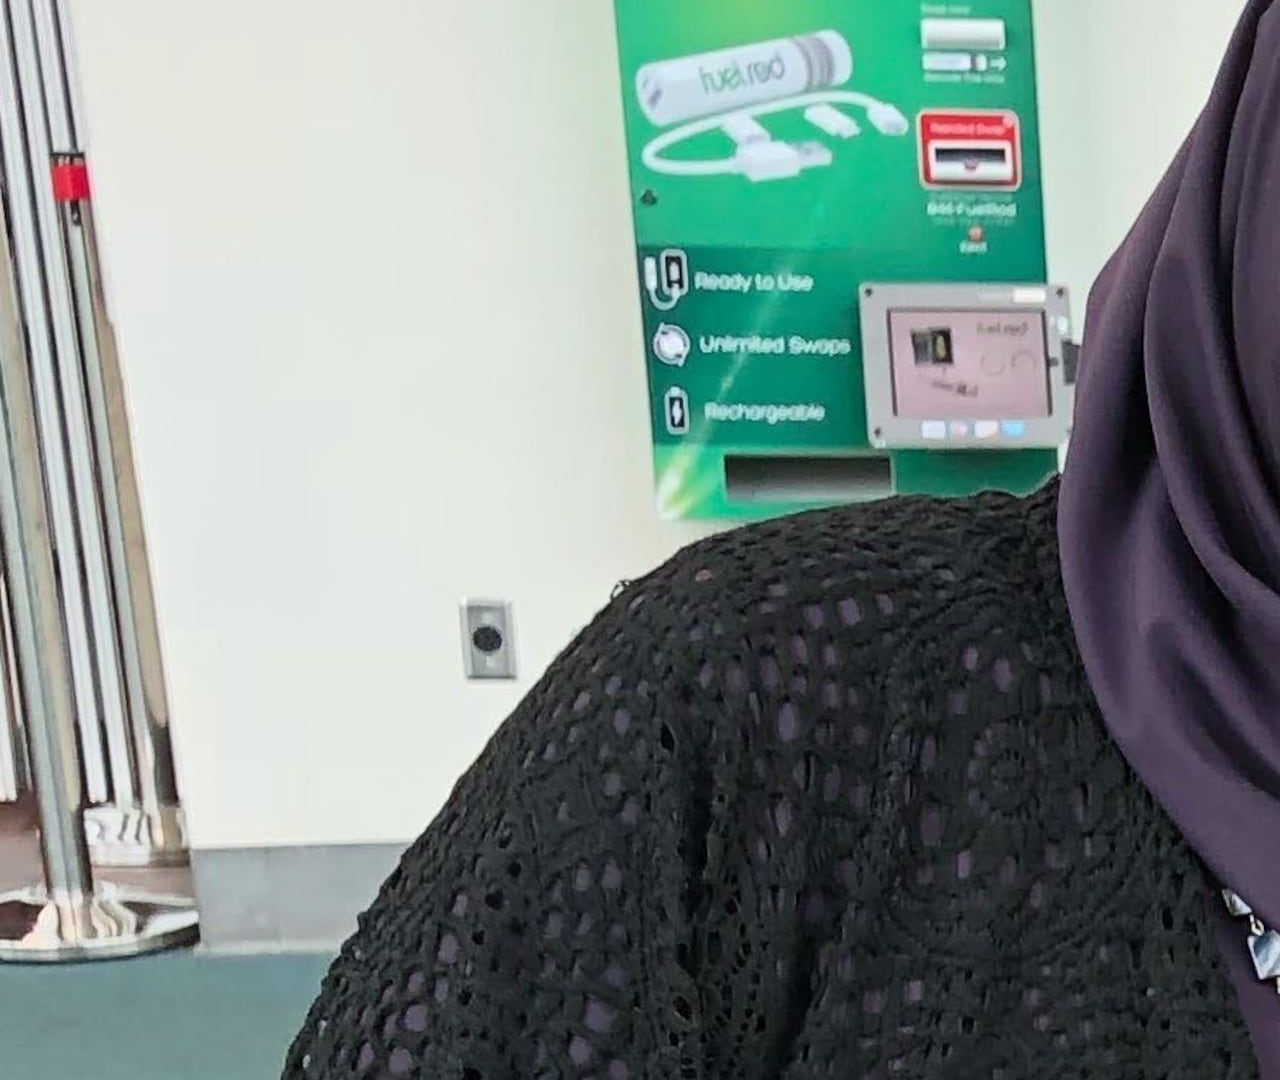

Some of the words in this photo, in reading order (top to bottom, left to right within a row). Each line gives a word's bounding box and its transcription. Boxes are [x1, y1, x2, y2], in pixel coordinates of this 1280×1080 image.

[694, 271, 751, 293] Ready
[755, 273, 775, 291] to
[777, 274, 814, 292] Use
[700, 335, 785, 353] Unlimited
[788, 335, 851, 356] Swaps
[704, 402, 825, 424] Rechargeable
